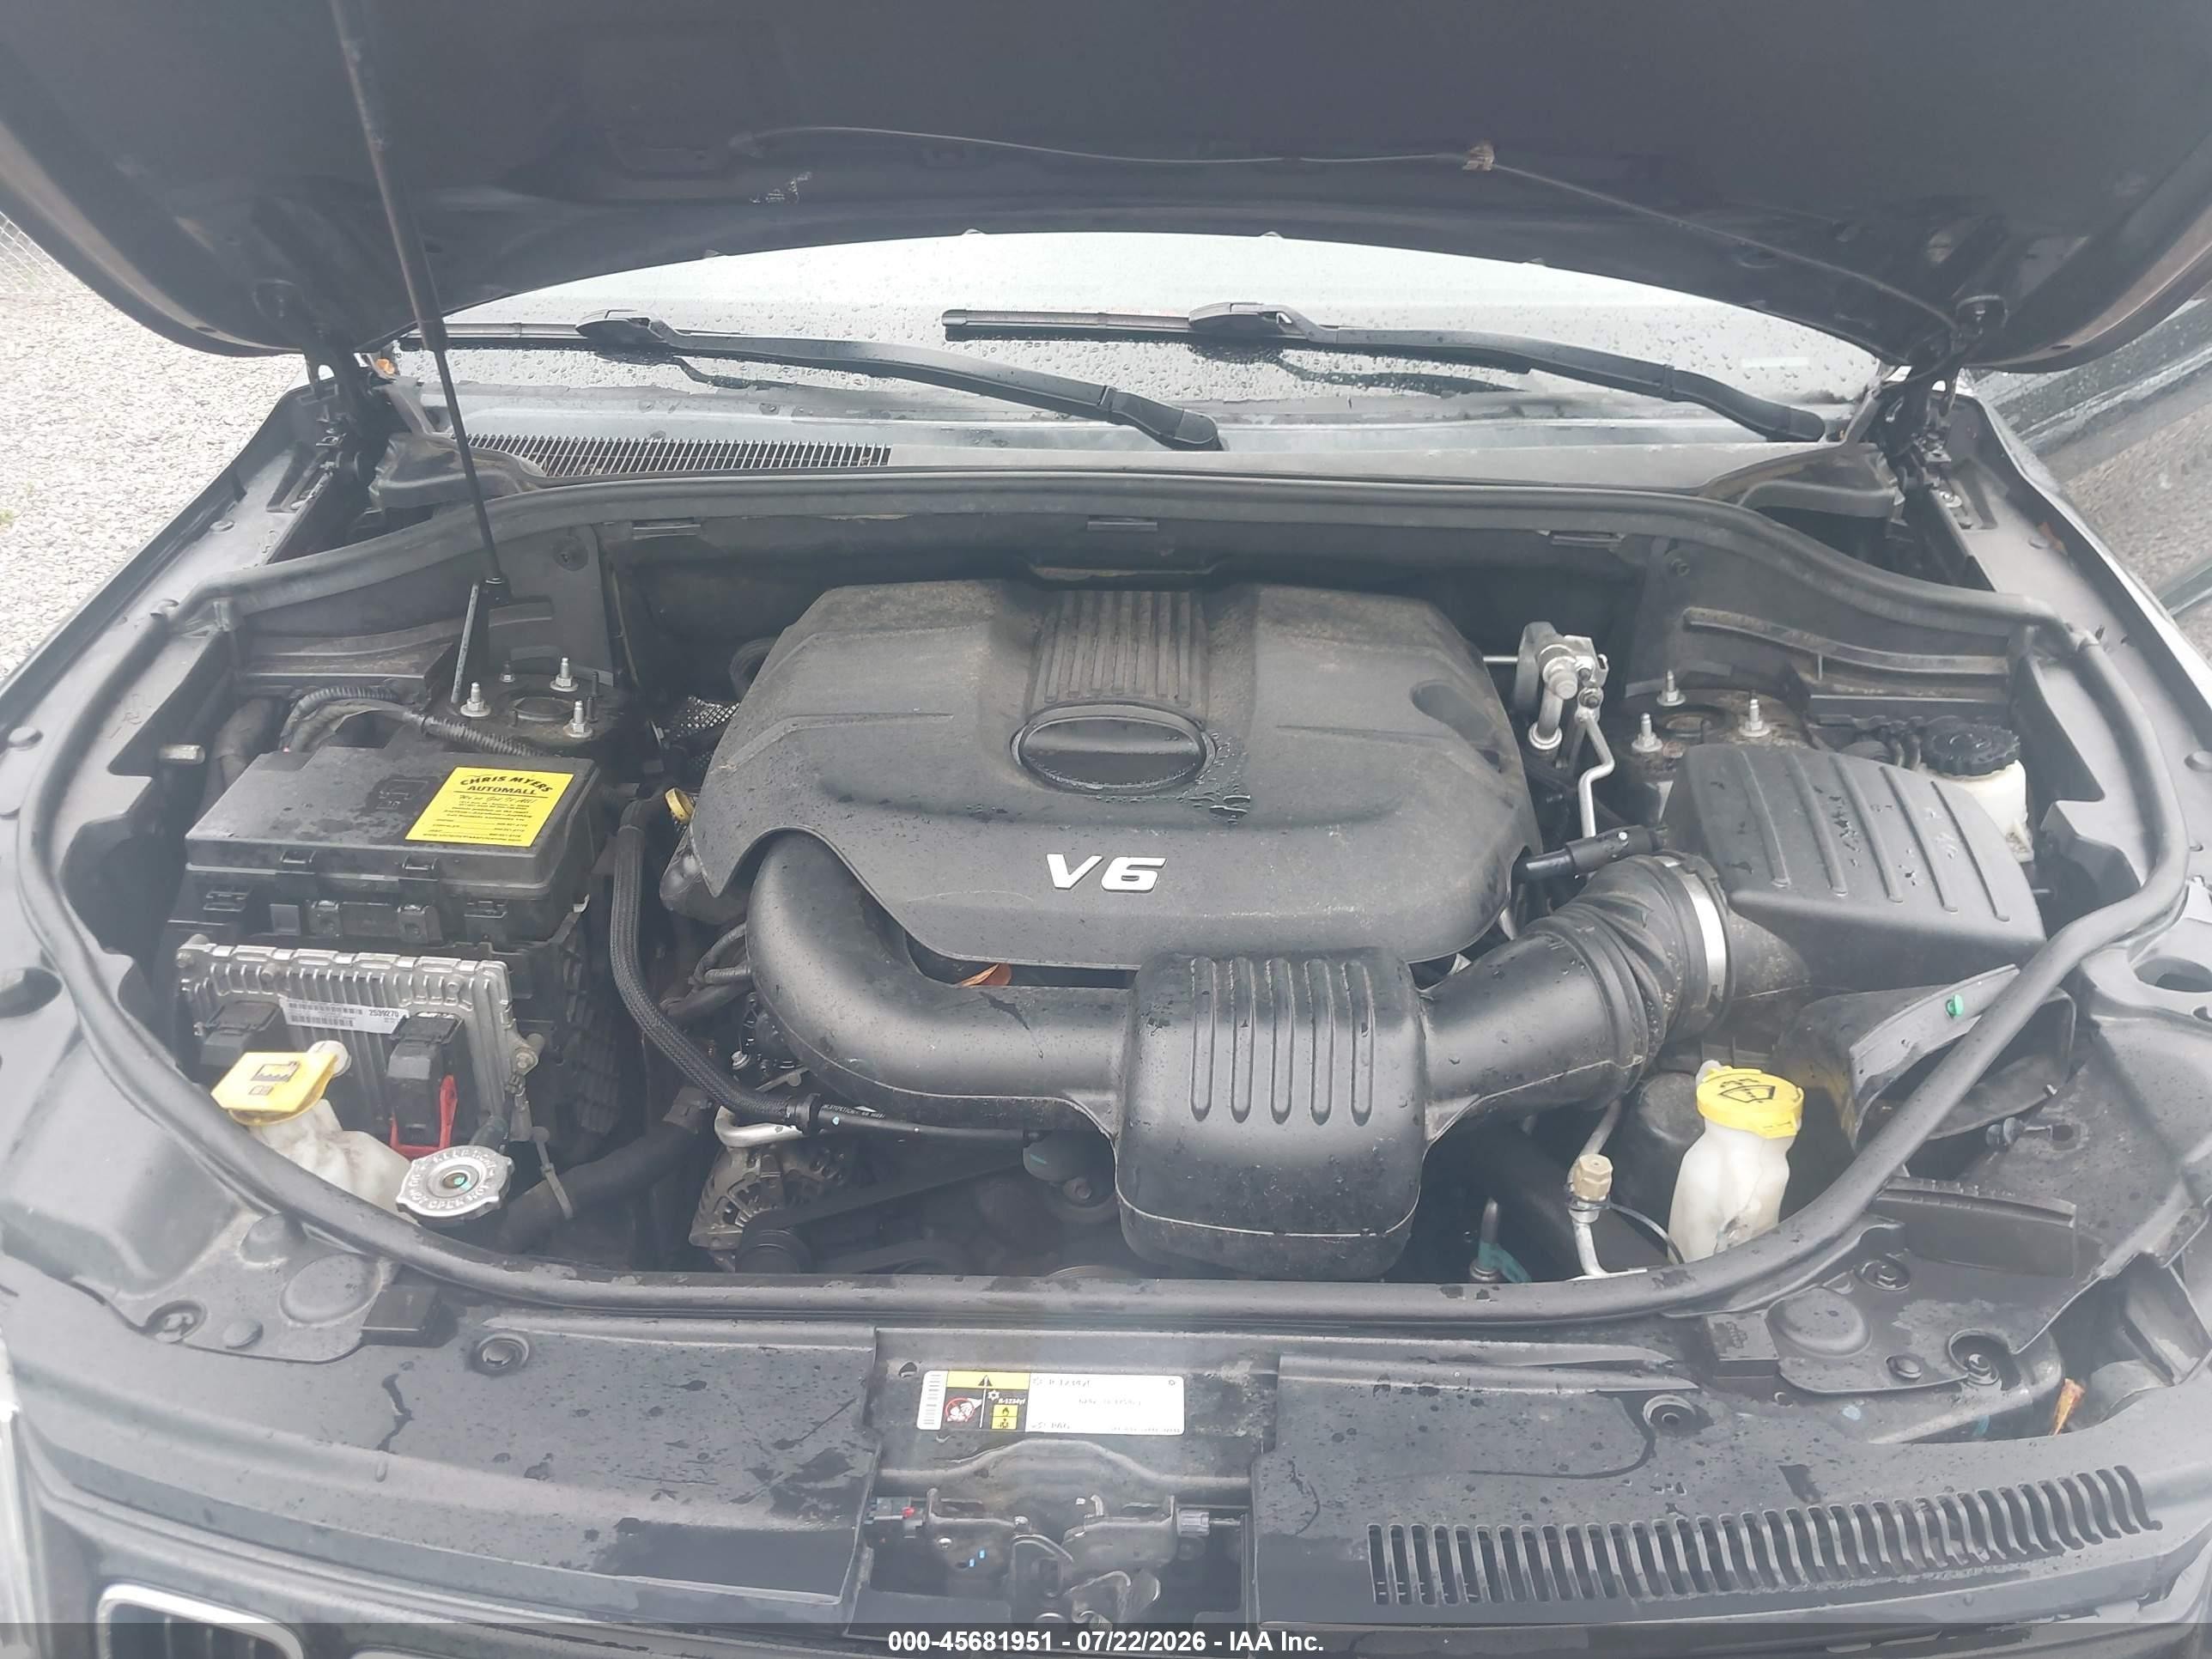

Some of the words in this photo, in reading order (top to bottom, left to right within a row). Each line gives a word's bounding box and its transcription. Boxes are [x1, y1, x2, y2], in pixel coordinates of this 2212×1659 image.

[459, 775, 507, 785] CHRIS
[509, 776, 554, 792] MYERS
[467, 786, 537, 794] AUTOMALL
[1047, 854, 1168, 893] V6
